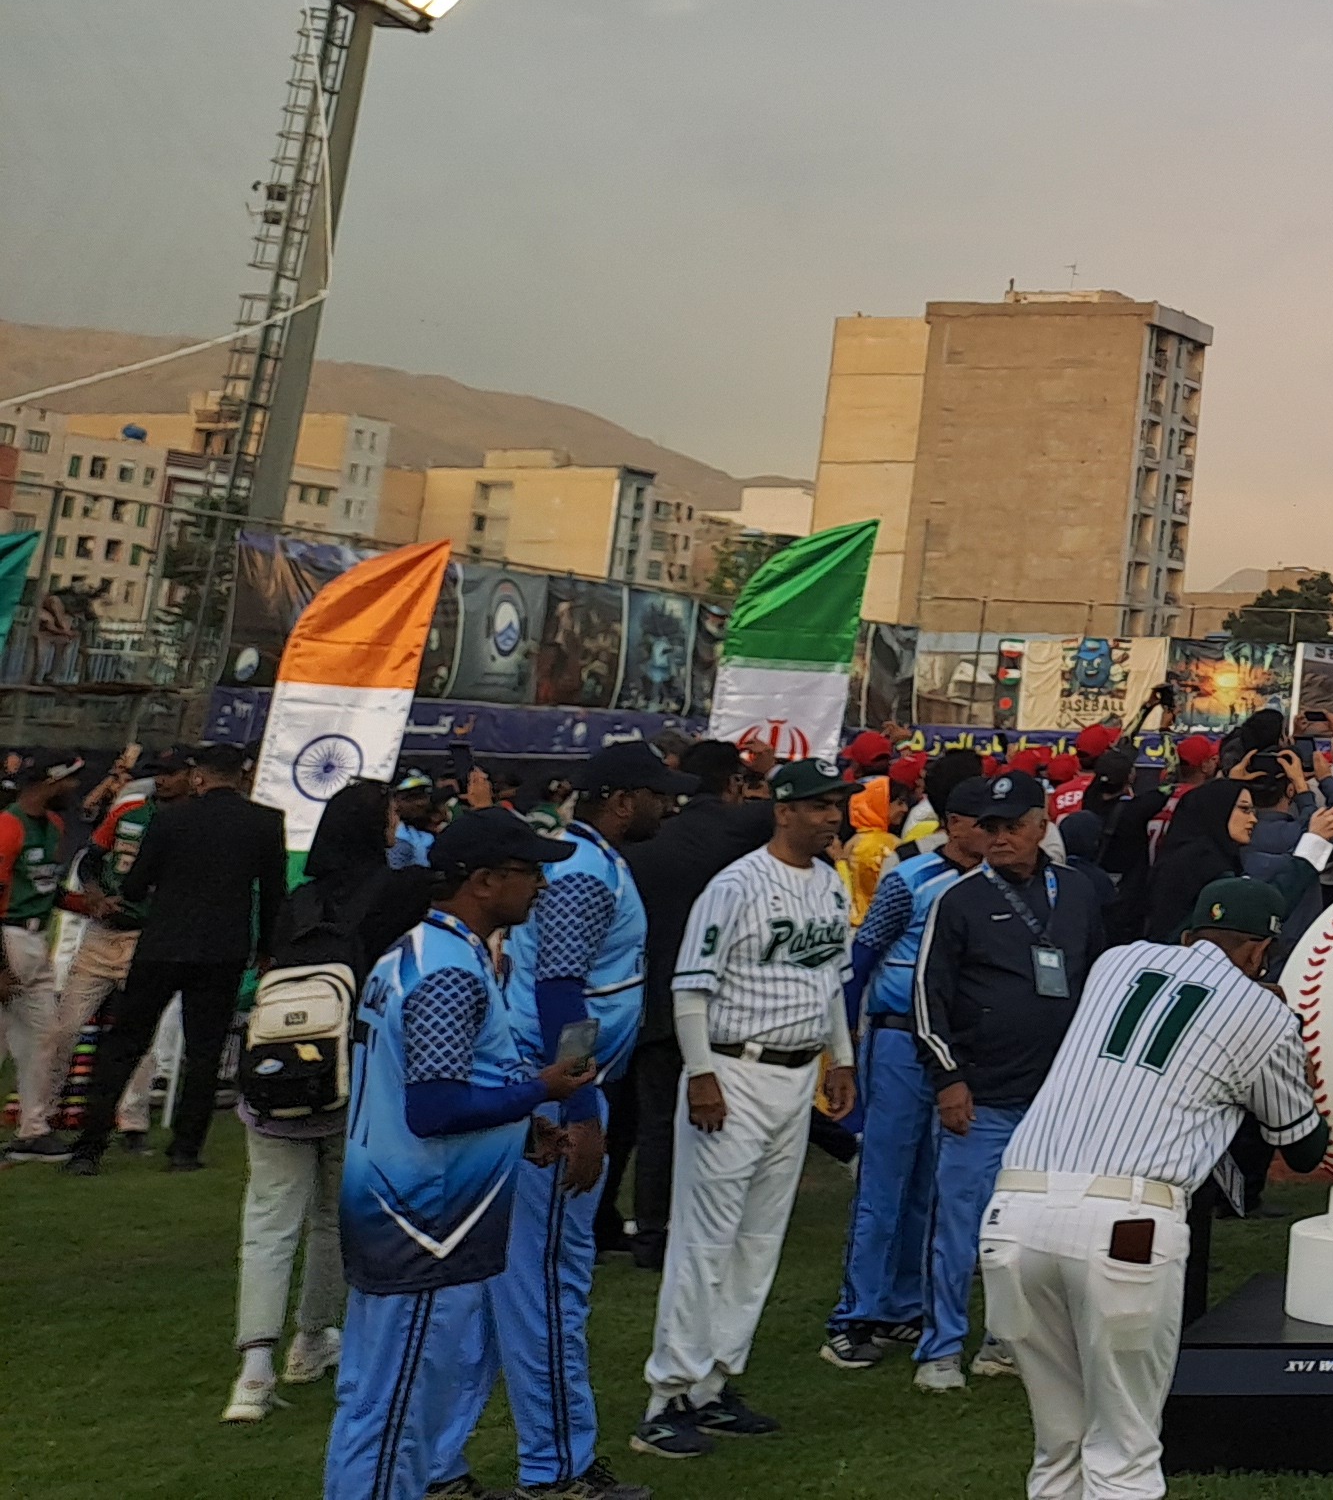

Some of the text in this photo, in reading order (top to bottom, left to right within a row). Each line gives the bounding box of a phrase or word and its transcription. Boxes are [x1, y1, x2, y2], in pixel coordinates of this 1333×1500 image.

[1059, 699, 1125, 713] BASEBALL
[700, 924, 719, 958] 9
[1098, 967, 1218, 1076] 11
[1283, 1360, 1317, 1372] XVI
